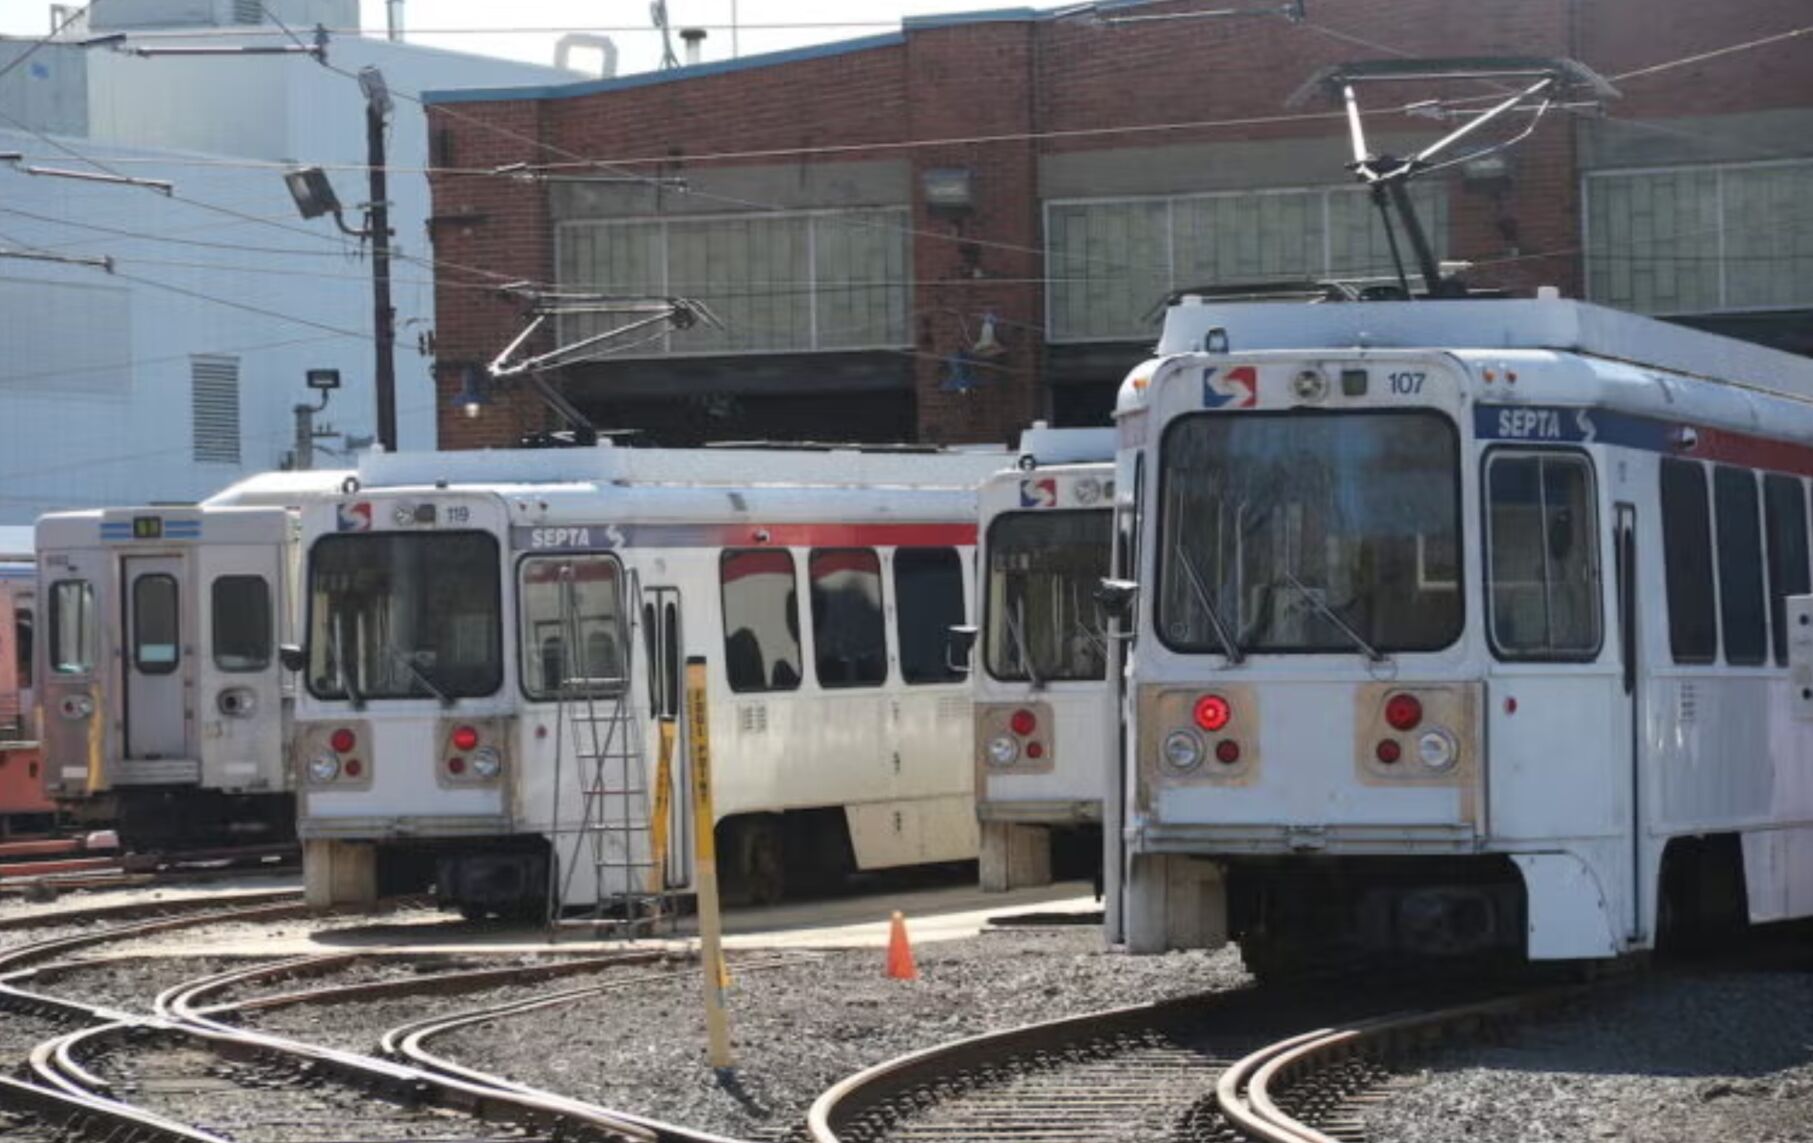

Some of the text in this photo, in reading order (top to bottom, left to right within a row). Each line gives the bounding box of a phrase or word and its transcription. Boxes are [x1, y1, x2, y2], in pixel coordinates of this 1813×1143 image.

[1387, 372, 1426, 394] 107
[1498, 409, 1561, 438] SEPTA
[446, 506, 470, 522] 119
[531, 528, 591, 549] SEPTA
